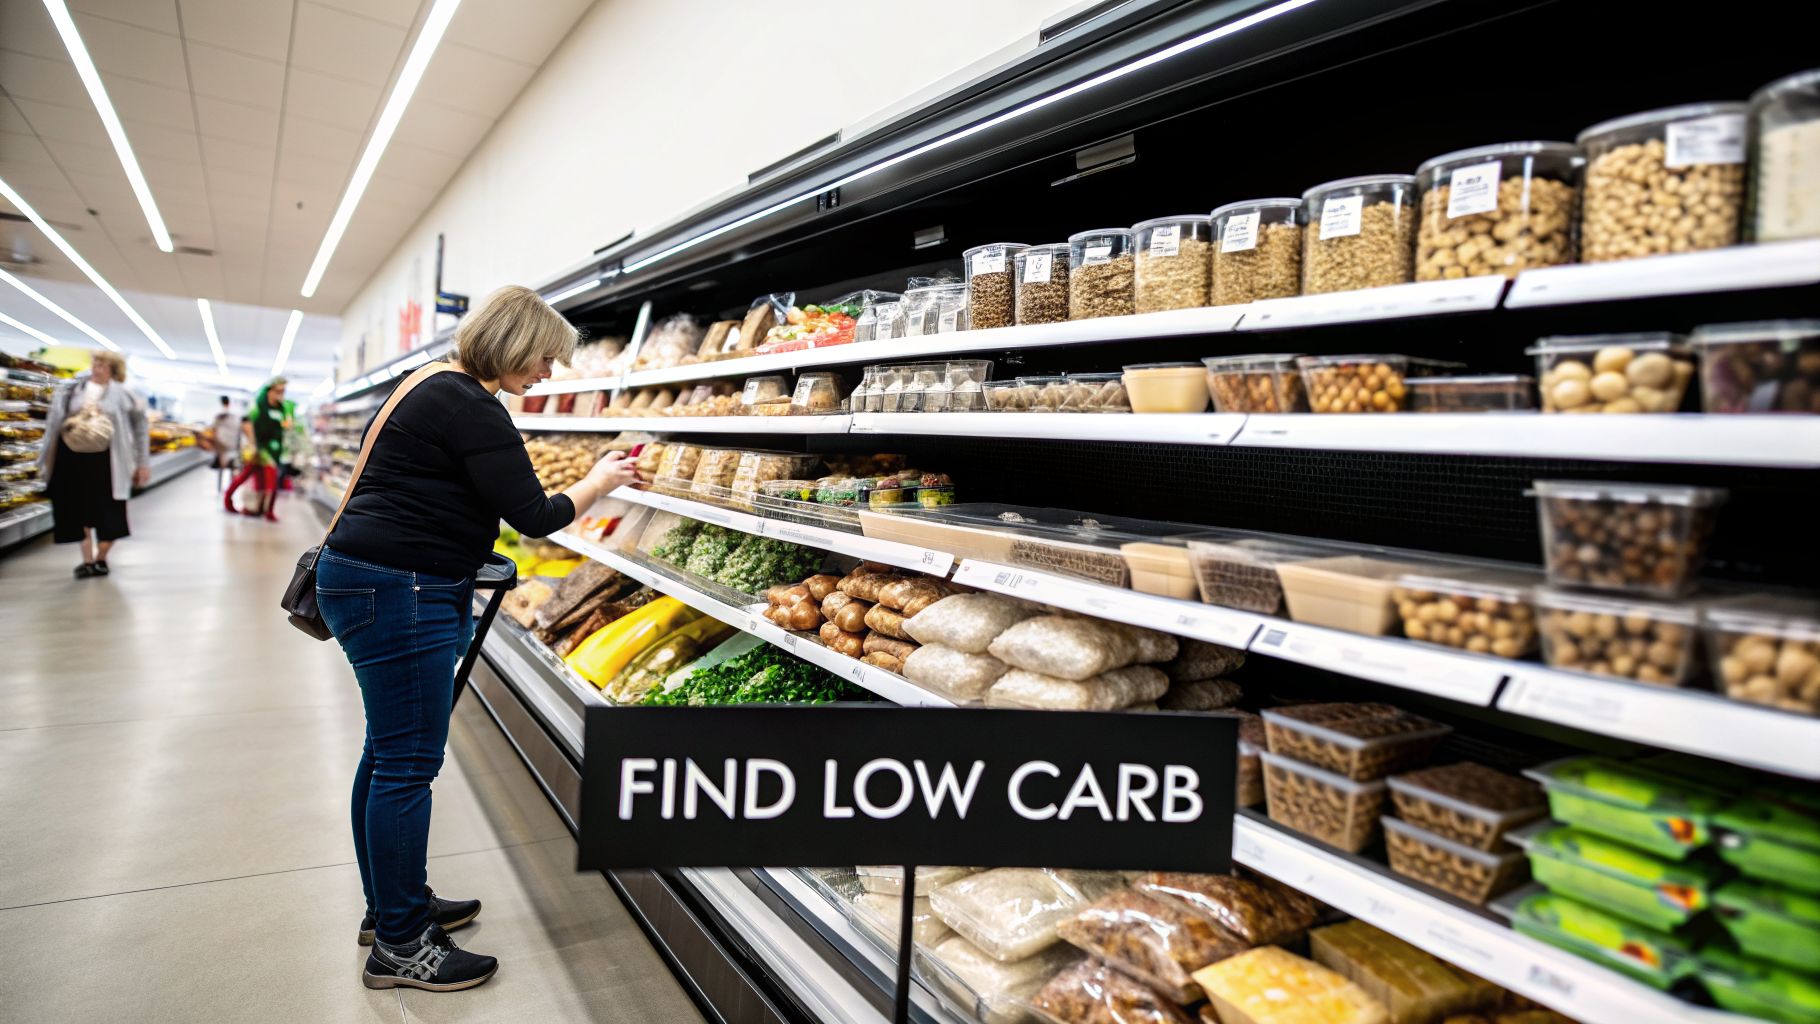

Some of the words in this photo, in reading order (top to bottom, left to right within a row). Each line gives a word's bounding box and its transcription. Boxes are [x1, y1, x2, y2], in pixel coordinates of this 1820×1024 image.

[618, 757, 796, 820] FIND
[823, 757, 985, 821] LOW
[1007, 760, 1203, 823] CARB
